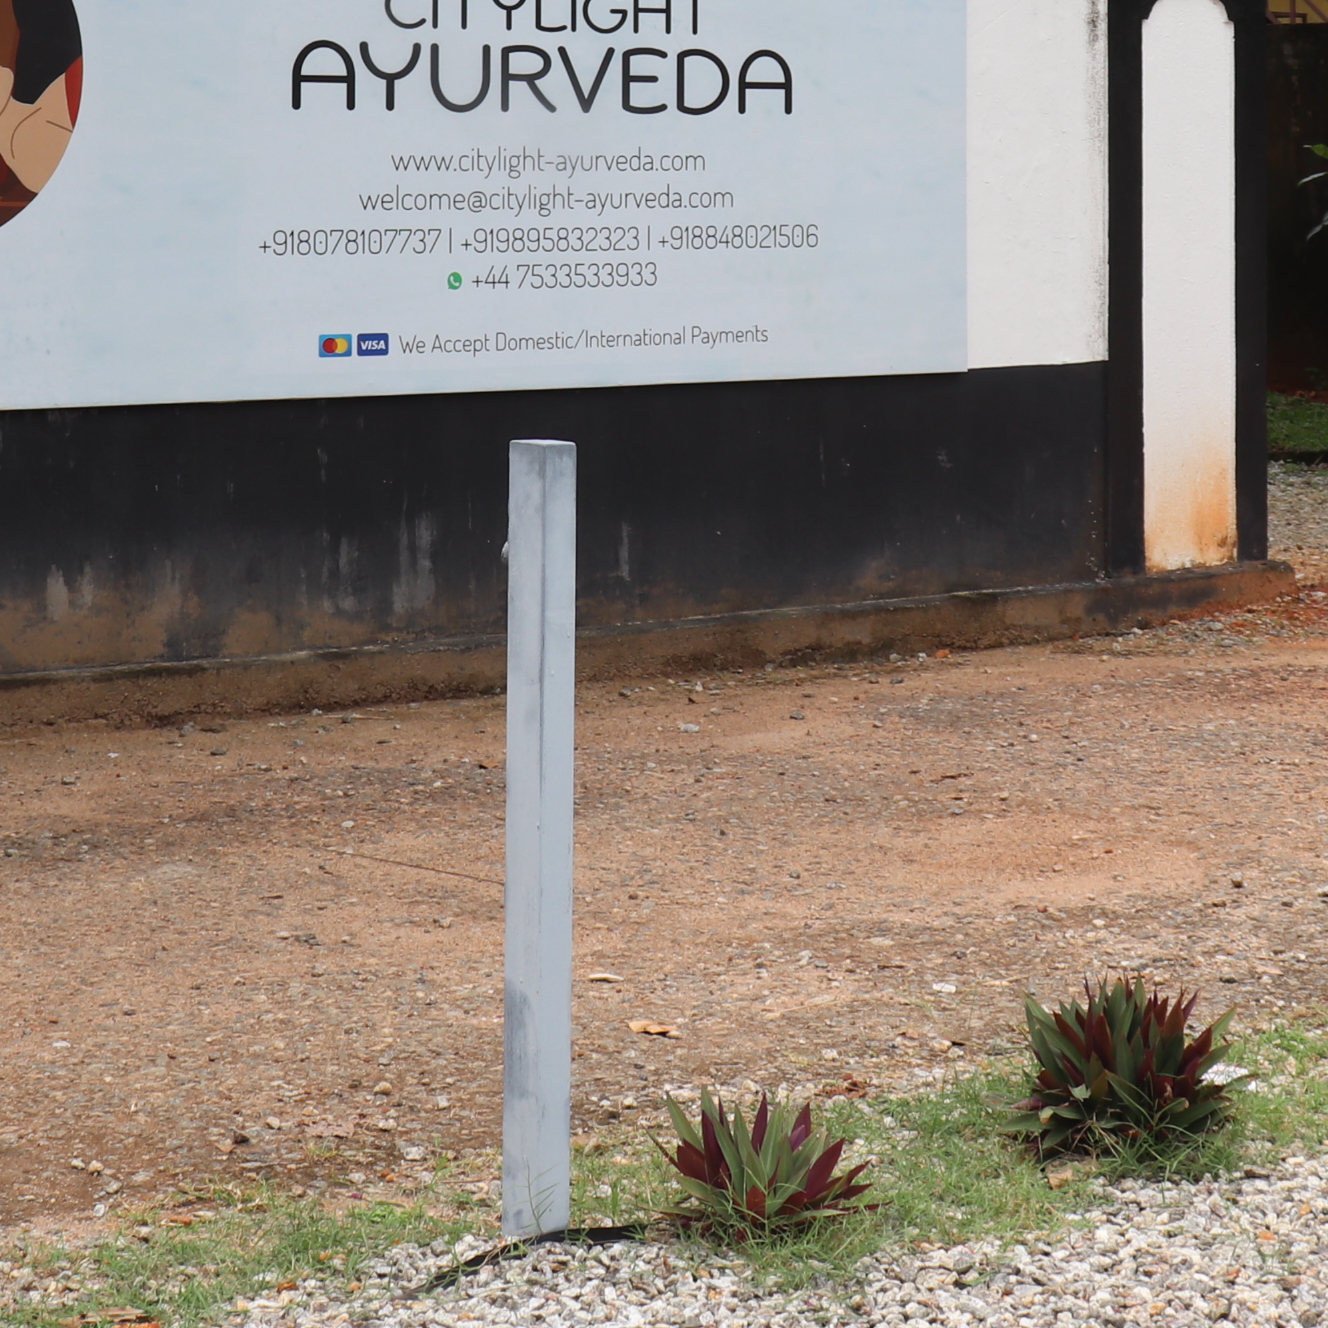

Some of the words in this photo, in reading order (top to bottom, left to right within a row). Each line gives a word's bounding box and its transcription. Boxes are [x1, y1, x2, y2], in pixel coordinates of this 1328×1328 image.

[291, 39, 793, 116] AYURVEDA
[391, 146, 706, 179] www.citylight-ayurveda.com
[358, 183, 734, 217] welcome@citylight-ayurveda.com
[258, 229, 441, 256] +918078107737
[460, 226, 640, 253] +919895832323
[657, 224, 819, 250] +918848021506
[471, 265, 511, 289] +44
[516, 262, 658, 289] 7533533933
[359, 340, 386, 351] VISA
[398, 334, 426, 354] We
[430, 333, 491, 357] Accept
[495, 326, 686, 352] Domestic/International
[691, 324, 769, 349] Payments
